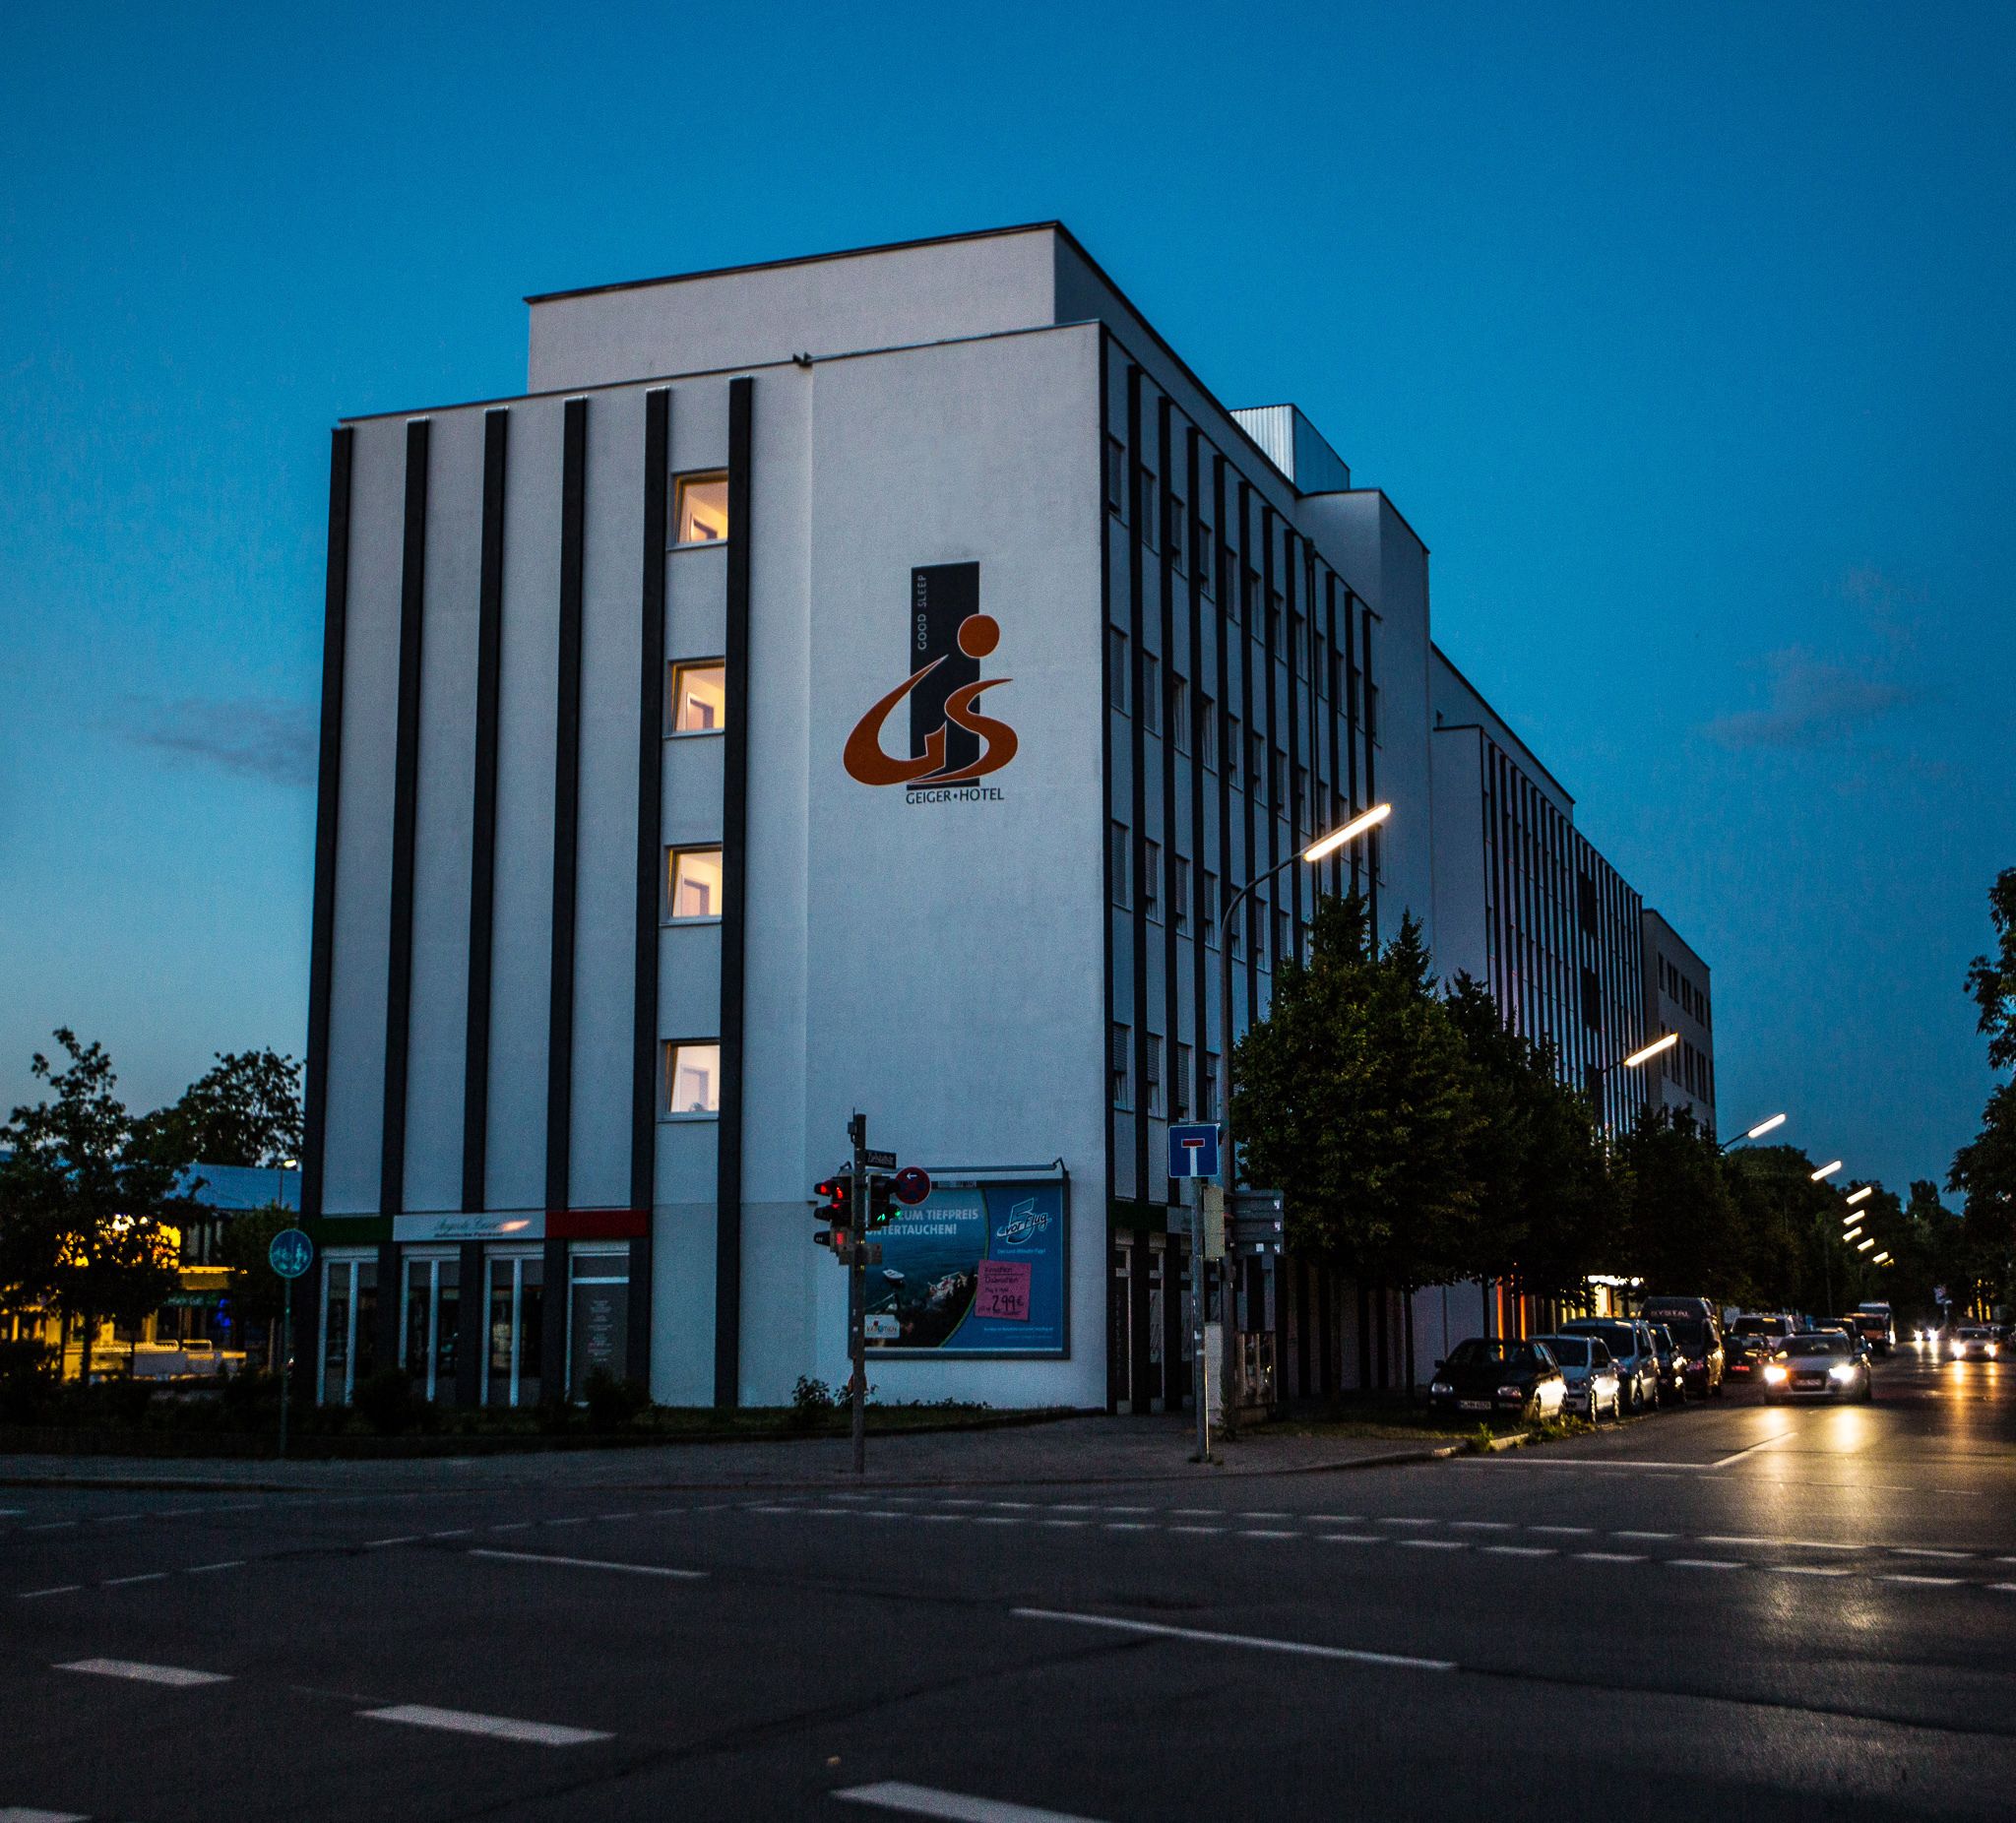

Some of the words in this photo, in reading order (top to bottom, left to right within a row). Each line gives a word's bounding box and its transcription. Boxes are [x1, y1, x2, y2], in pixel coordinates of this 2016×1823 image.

[916, 574, 927, 607] SLEEP
[916, 613, 927, 651] GOOD
[926, 1208, 979, 1221] TIEFPREIS
